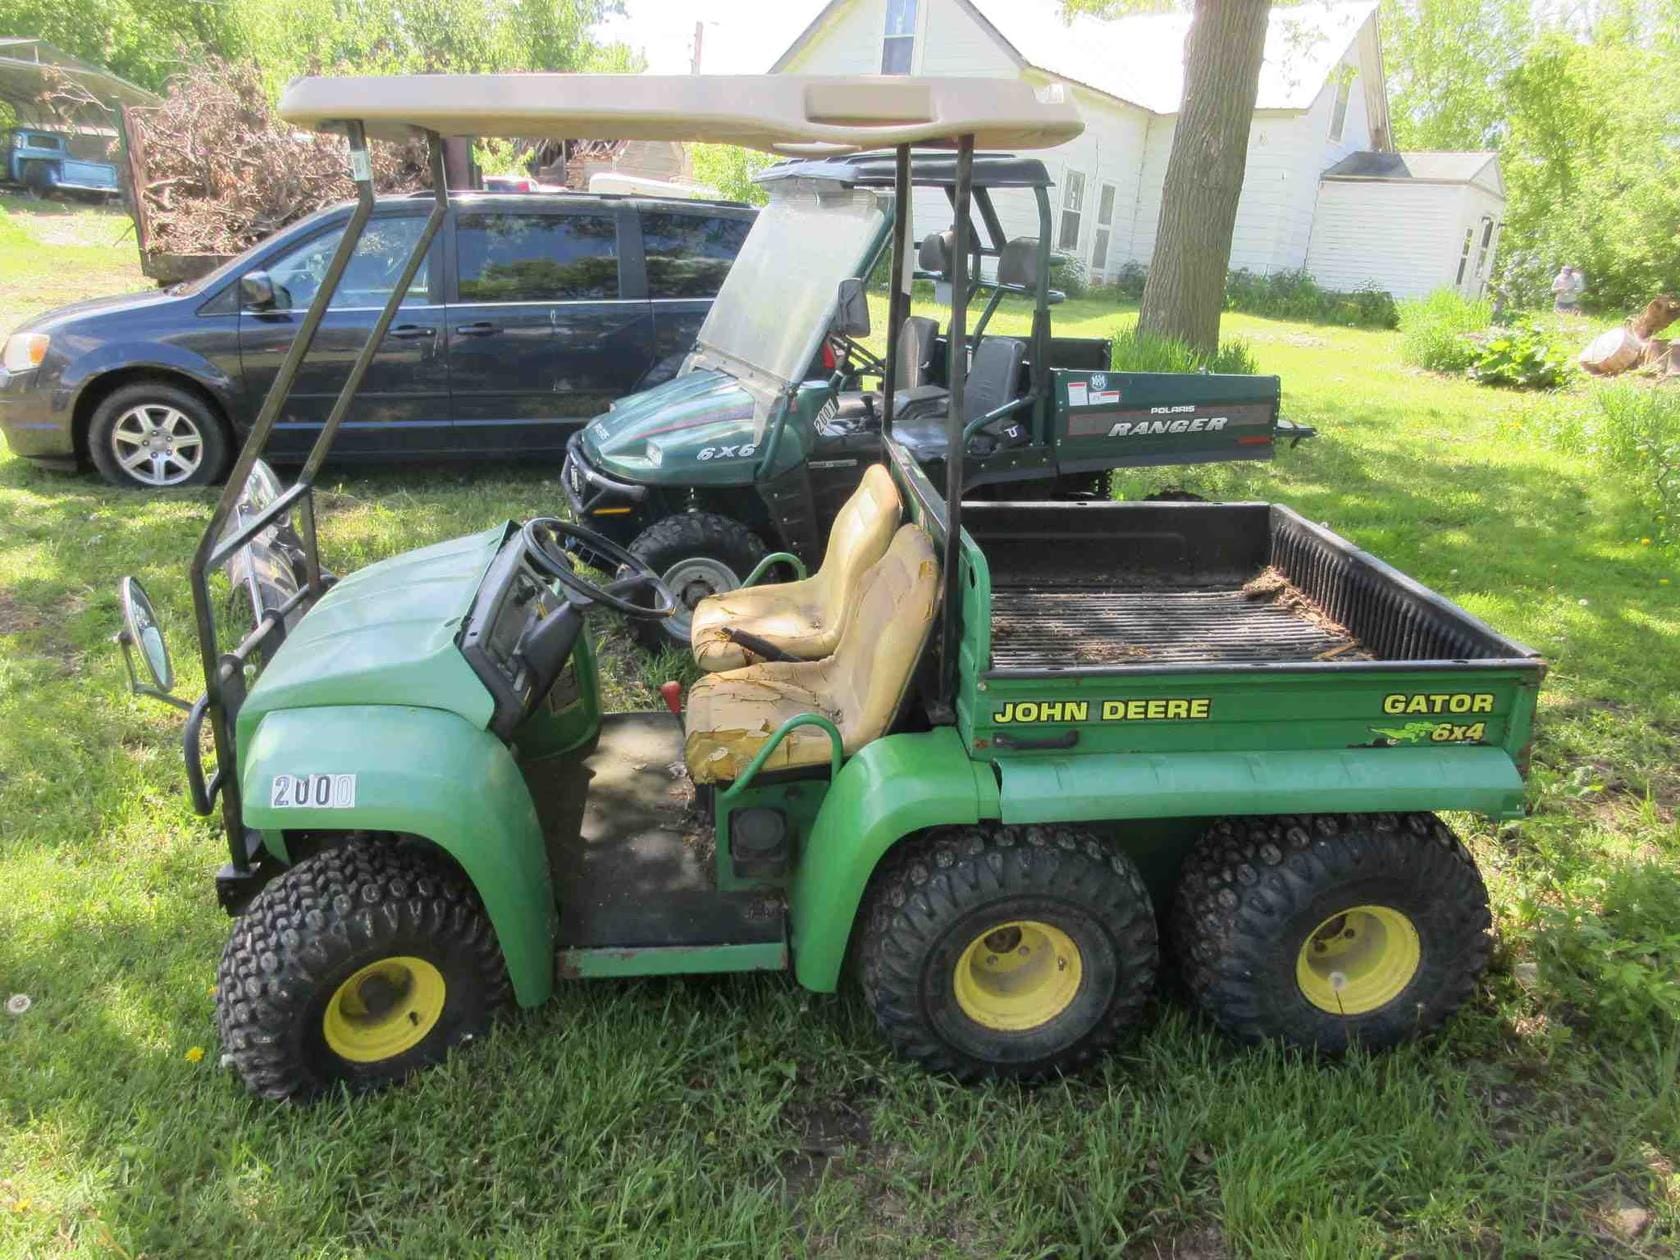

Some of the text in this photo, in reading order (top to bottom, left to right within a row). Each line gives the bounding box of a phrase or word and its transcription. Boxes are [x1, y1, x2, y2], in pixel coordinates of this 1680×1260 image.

[814, 399, 836, 435] 2001
[1150, 405, 1196, 415] POLARIS
[1108, 416, 1228, 437] RANGER
[696, 443, 757, 461] 6X6
[993, 698, 1211, 723] JOHN DEERE
[1383, 693, 1495, 714] GATOR
[1430, 721, 1486, 742] 6x4
[274, 776, 353, 806] 2000
